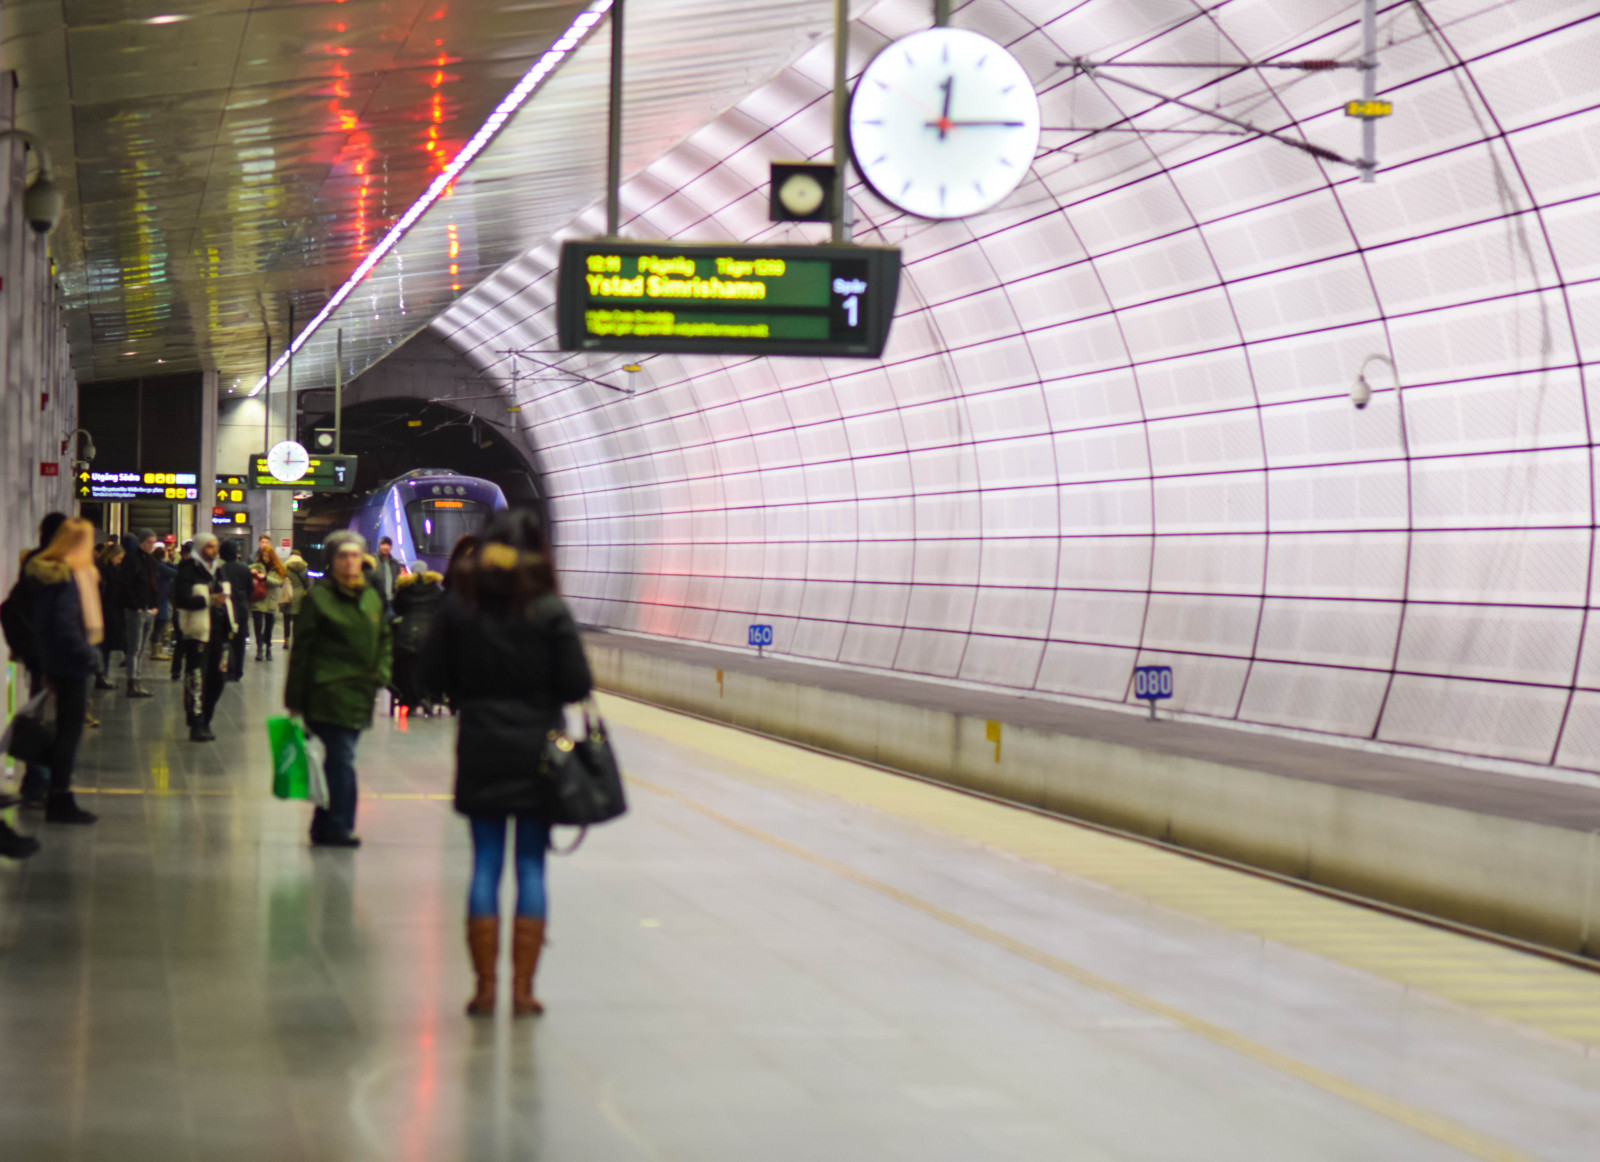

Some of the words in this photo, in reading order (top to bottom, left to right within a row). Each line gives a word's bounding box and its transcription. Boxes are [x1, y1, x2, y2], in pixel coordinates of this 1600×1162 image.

[586, 274, 645, 296] Ystad
[646, 275, 766, 299] Simrishamn
[842, 295, 858, 326] 1
[337, 471, 344, 482] 1
[750, 626, 771, 643] 160
[1136, 670, 1171, 695] 080
